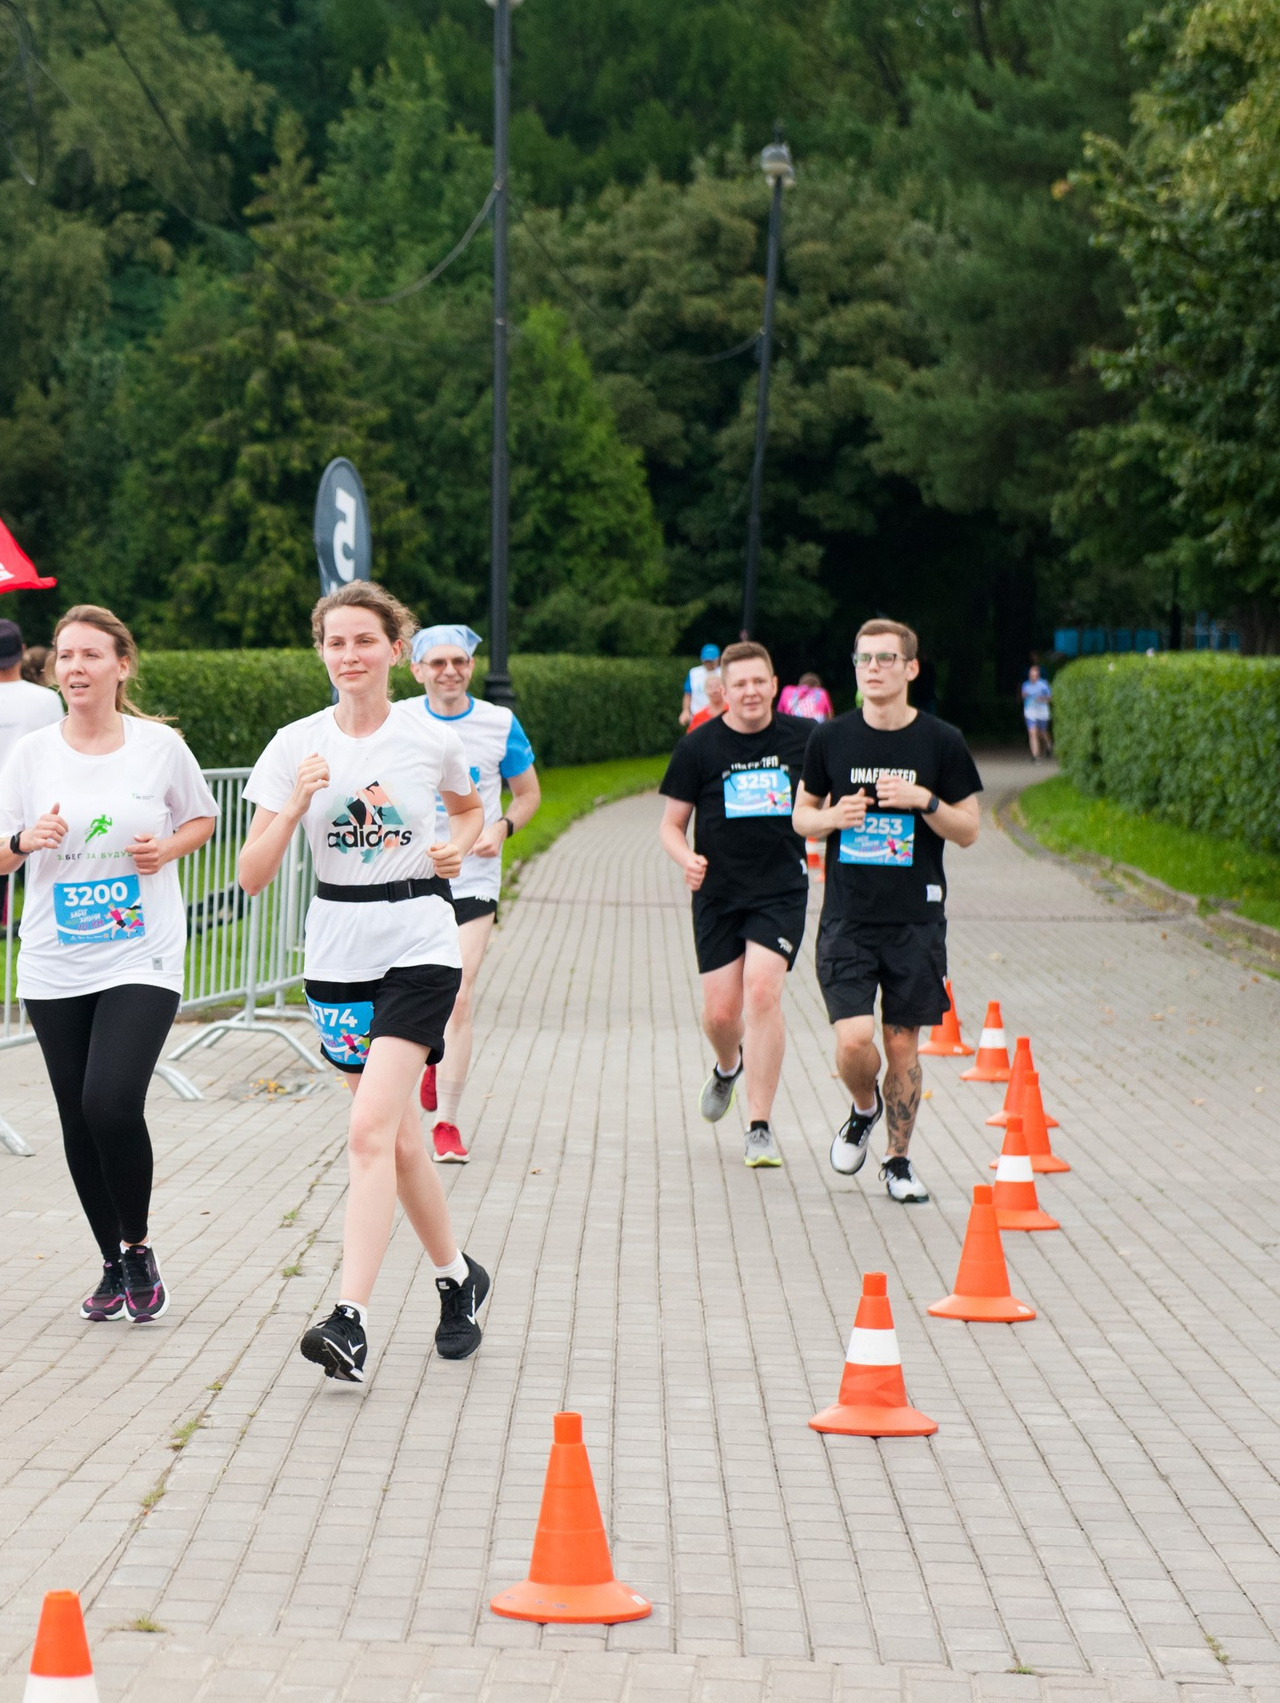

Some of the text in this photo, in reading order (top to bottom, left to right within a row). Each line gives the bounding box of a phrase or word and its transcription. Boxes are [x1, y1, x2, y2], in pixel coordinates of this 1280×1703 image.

[736, 772, 778, 790] 3251
[327, 825, 412, 848] adidas
[57, 853, 82, 861] ЗБЕГ
[63, 881, 128, 907] 3200
